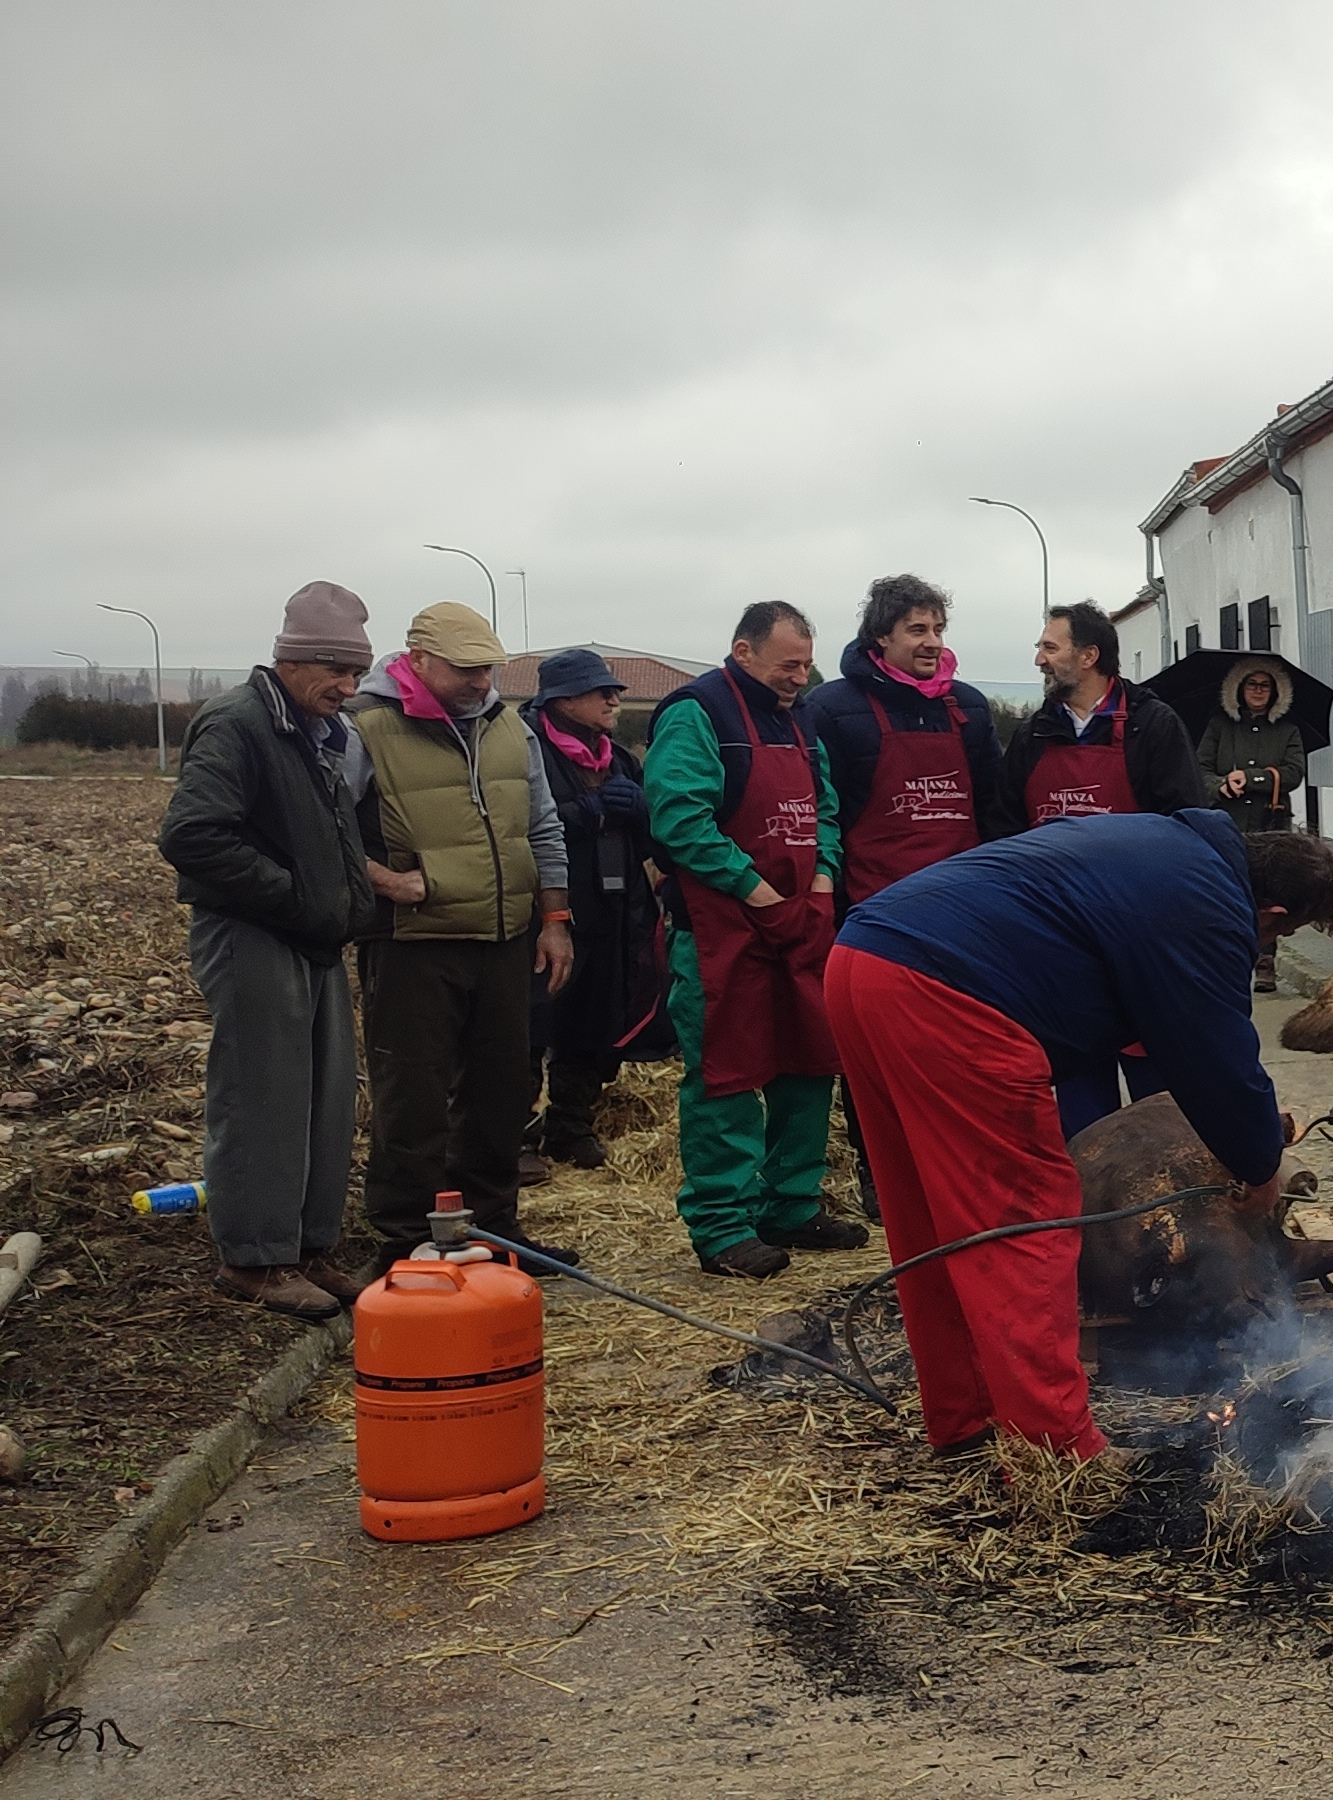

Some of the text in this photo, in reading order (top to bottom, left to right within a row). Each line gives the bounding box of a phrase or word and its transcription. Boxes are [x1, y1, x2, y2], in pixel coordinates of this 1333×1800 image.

[904, 772, 959, 790] MATANZA
[1049, 786, 1098, 802] MATANZA
[436, 1377, 476, 1388] Propano
